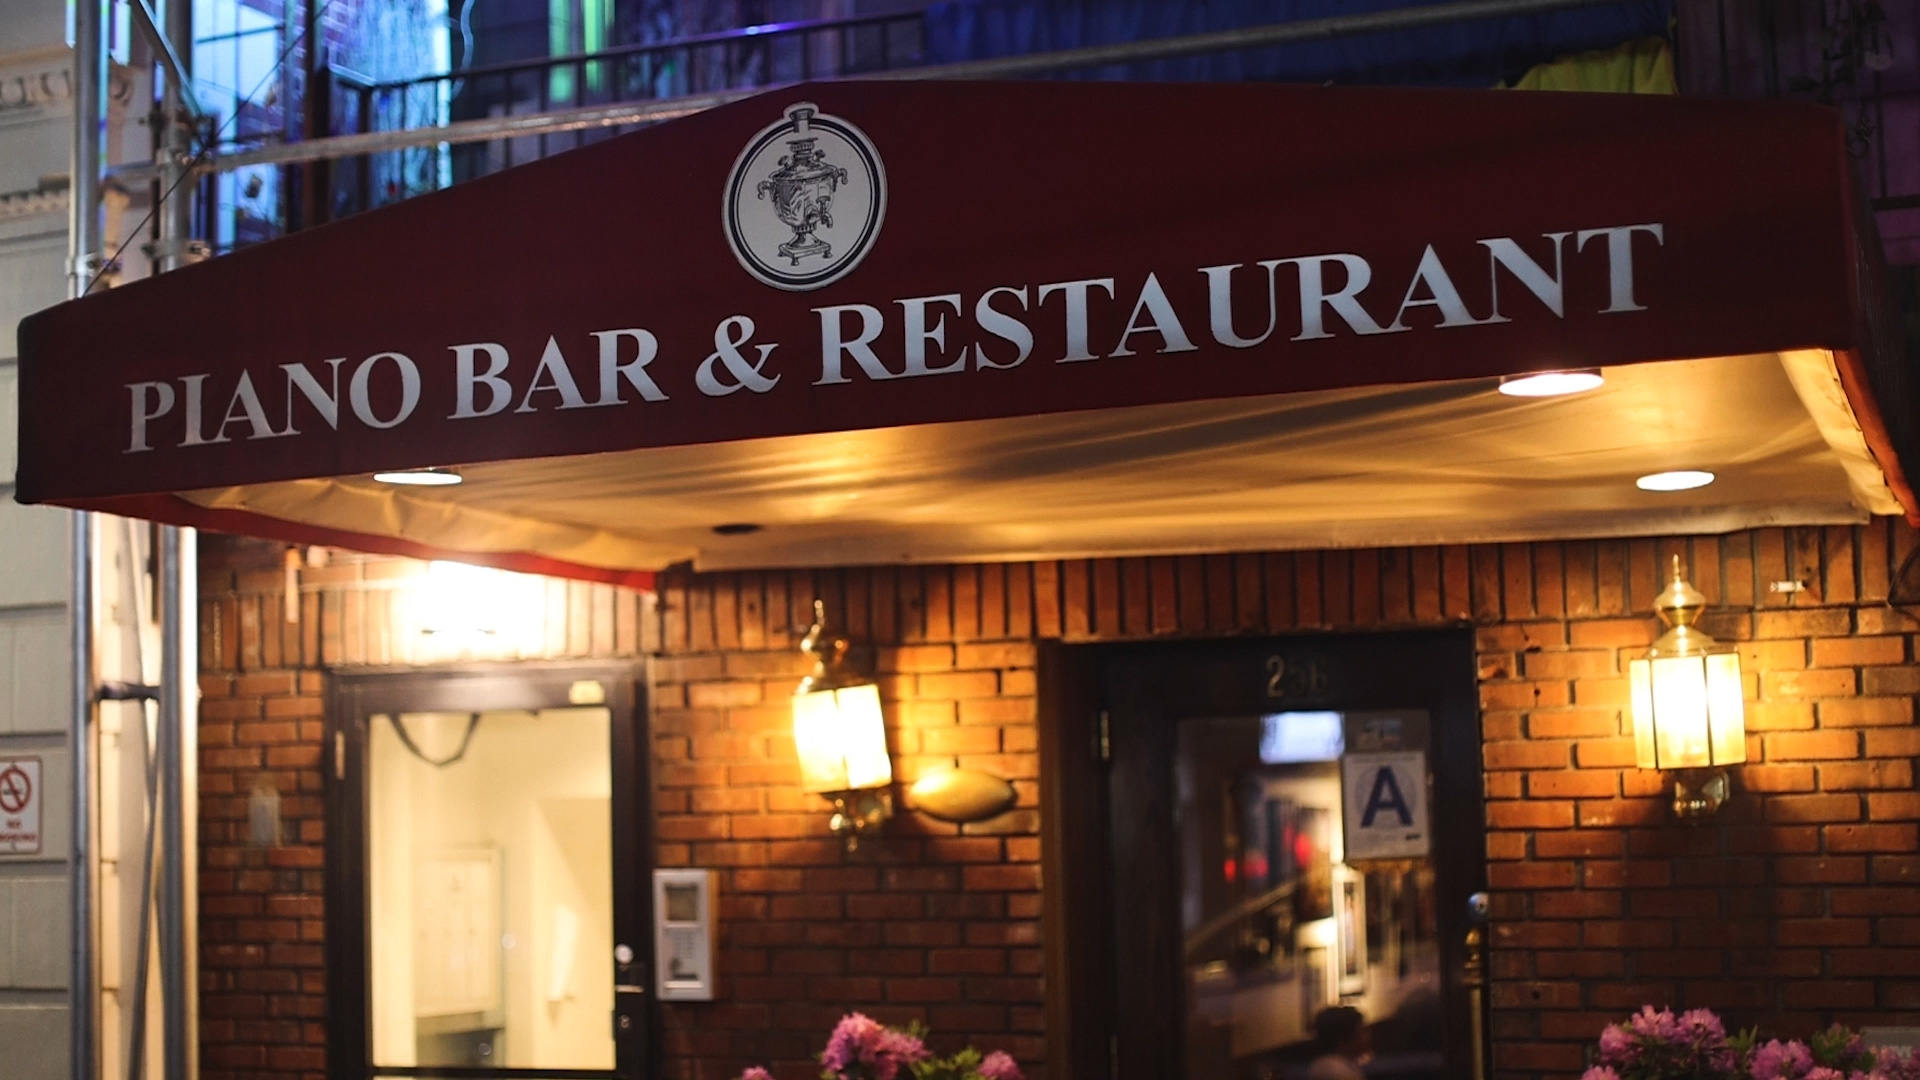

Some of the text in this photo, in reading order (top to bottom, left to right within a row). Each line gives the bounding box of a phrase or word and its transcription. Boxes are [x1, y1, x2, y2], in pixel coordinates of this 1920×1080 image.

[122, 223, 1664, 453] PIANO BAR & RESTAURANT
[1360, 765, 1414, 829] A
